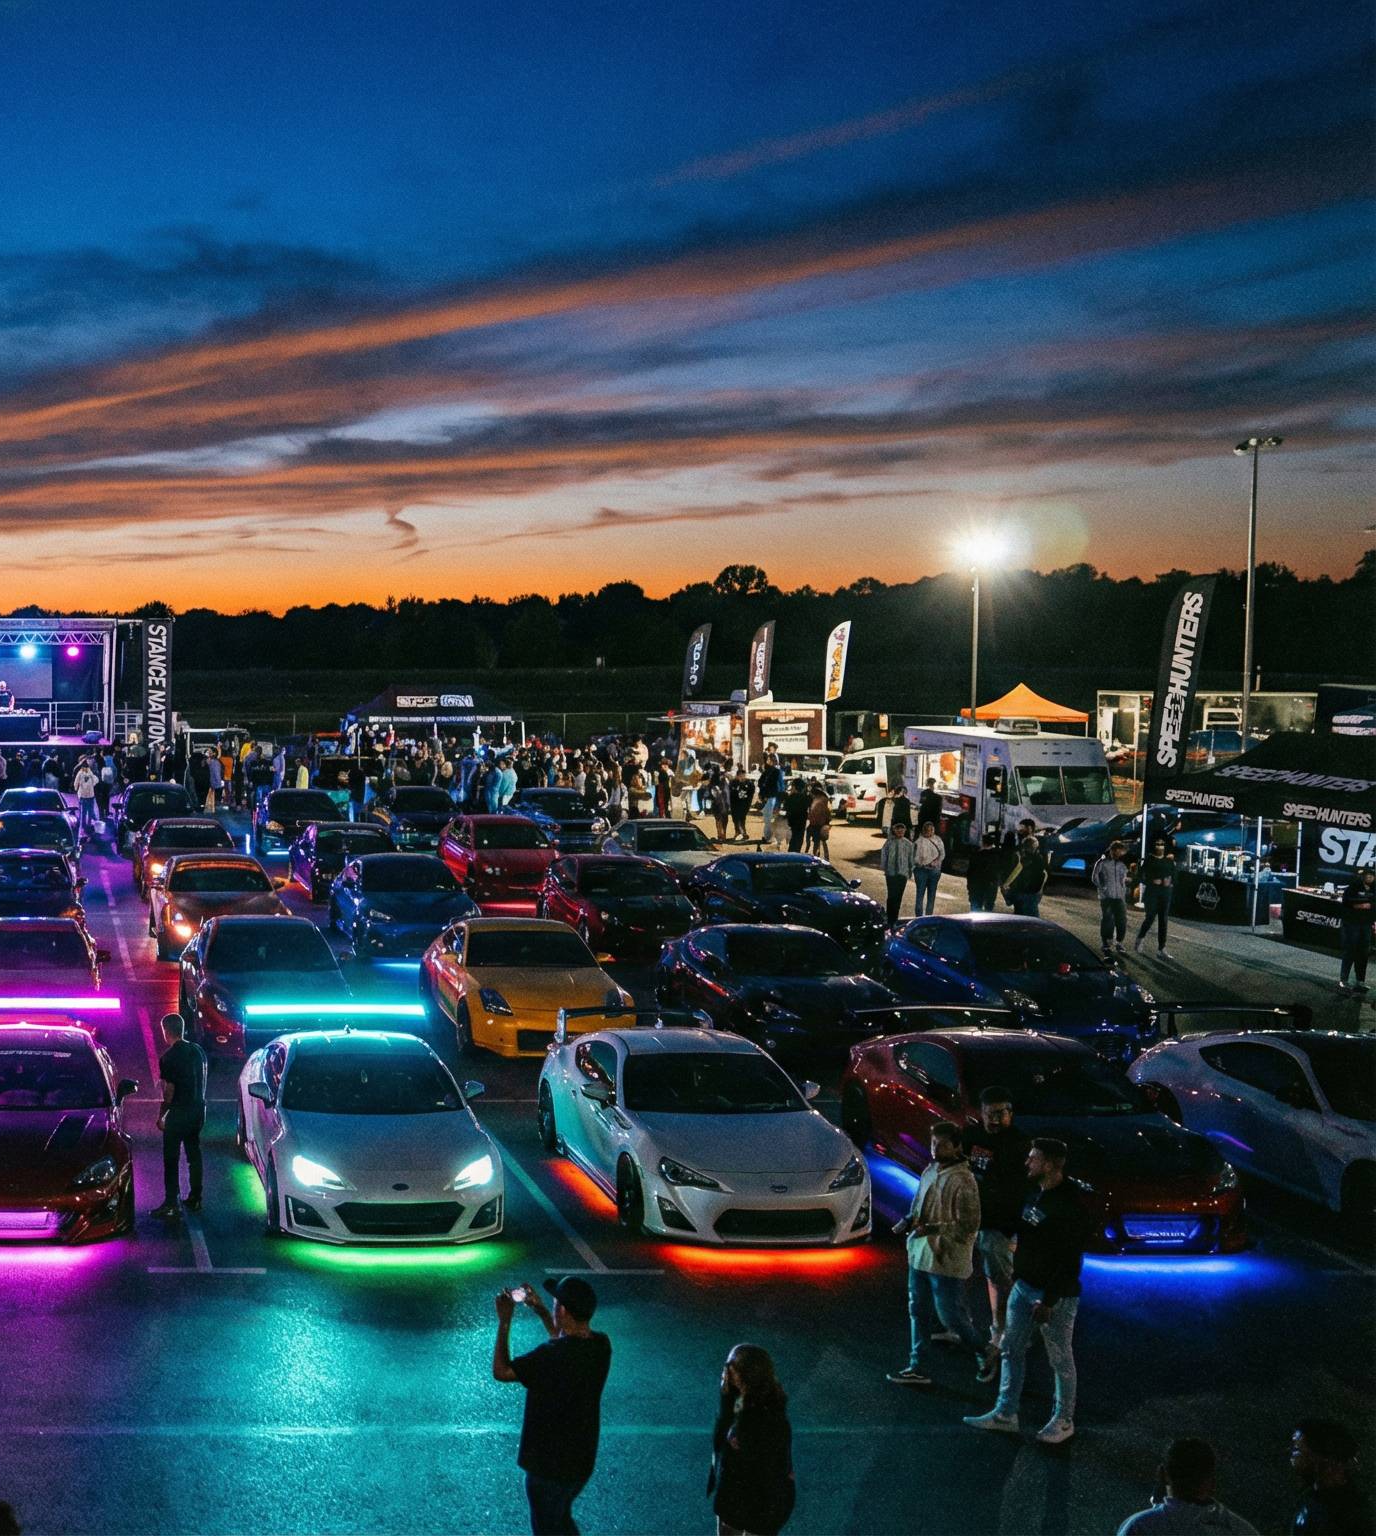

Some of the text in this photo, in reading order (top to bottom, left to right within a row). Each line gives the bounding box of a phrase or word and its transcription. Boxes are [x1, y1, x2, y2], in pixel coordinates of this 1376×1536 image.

[148, 624, 167, 748] STANCE NATION
[1282, 803, 1372, 828] SPEEDHUNTERS
